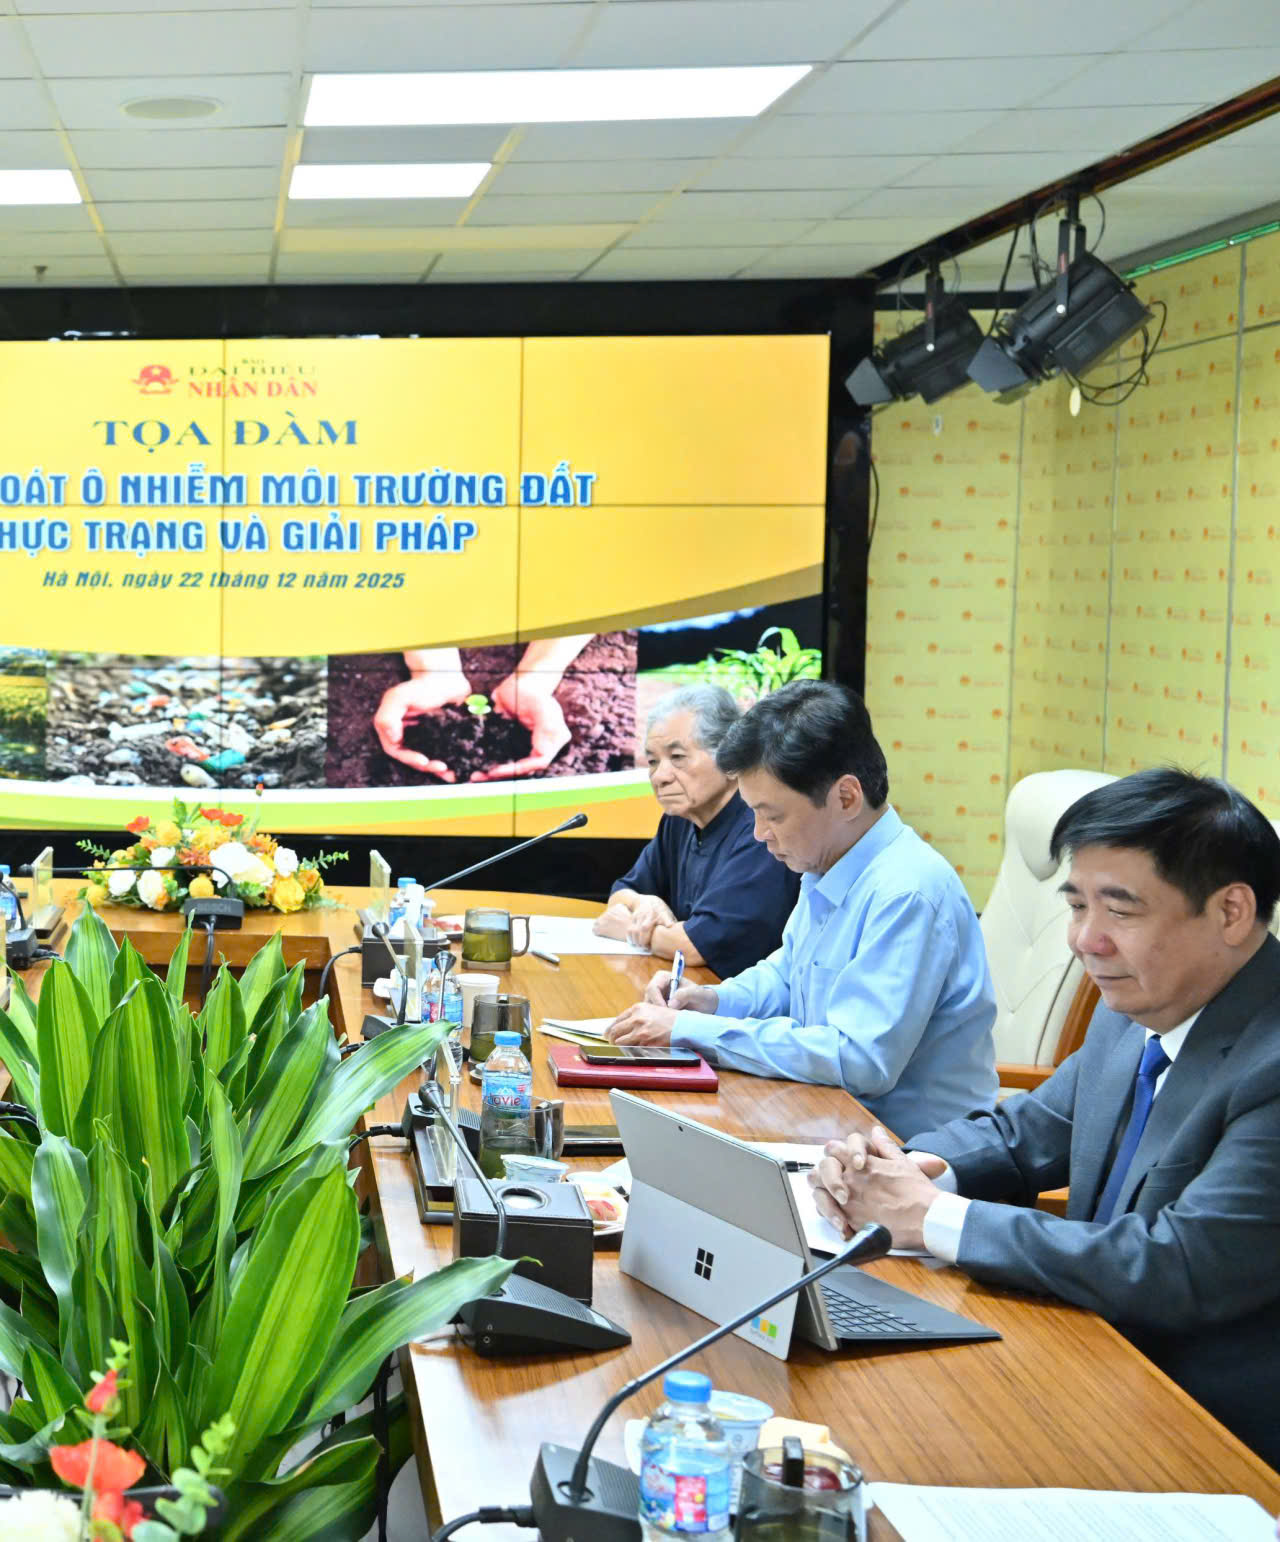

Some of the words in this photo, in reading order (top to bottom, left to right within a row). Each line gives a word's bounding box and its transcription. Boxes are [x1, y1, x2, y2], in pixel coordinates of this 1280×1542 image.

[188, 376, 258, 399] NHÂN
[266, 376, 318, 399] DÂN
[92, 420, 211, 453] TỌA
[232, 411, 358, 446] ĐÀM
[82, 468, 103, 505] Ô
[120, 463, 245, 505] NHIỄM
[261, 468, 336, 505] MÔI
[353, 468, 505, 505] TRƯỜNG
[518, 461, 595, 505] ĐẤT
[84, 520, 204, 557] TRẠNG
[219, 514, 267, 551] VÀ
[282, 512, 358, 551] GIẢI
[375, 514, 475, 551] PHÁP
[42, 570, 69, 588] Hà
[122, 571, 174, 589] ngày
[178, 571, 204, 588] 22
[209, 571, 269, 590] tháng
[276, 571, 297, 588] 12
[302, 571, 349, 588] năm
[354, 571, 406, 589] 2025
